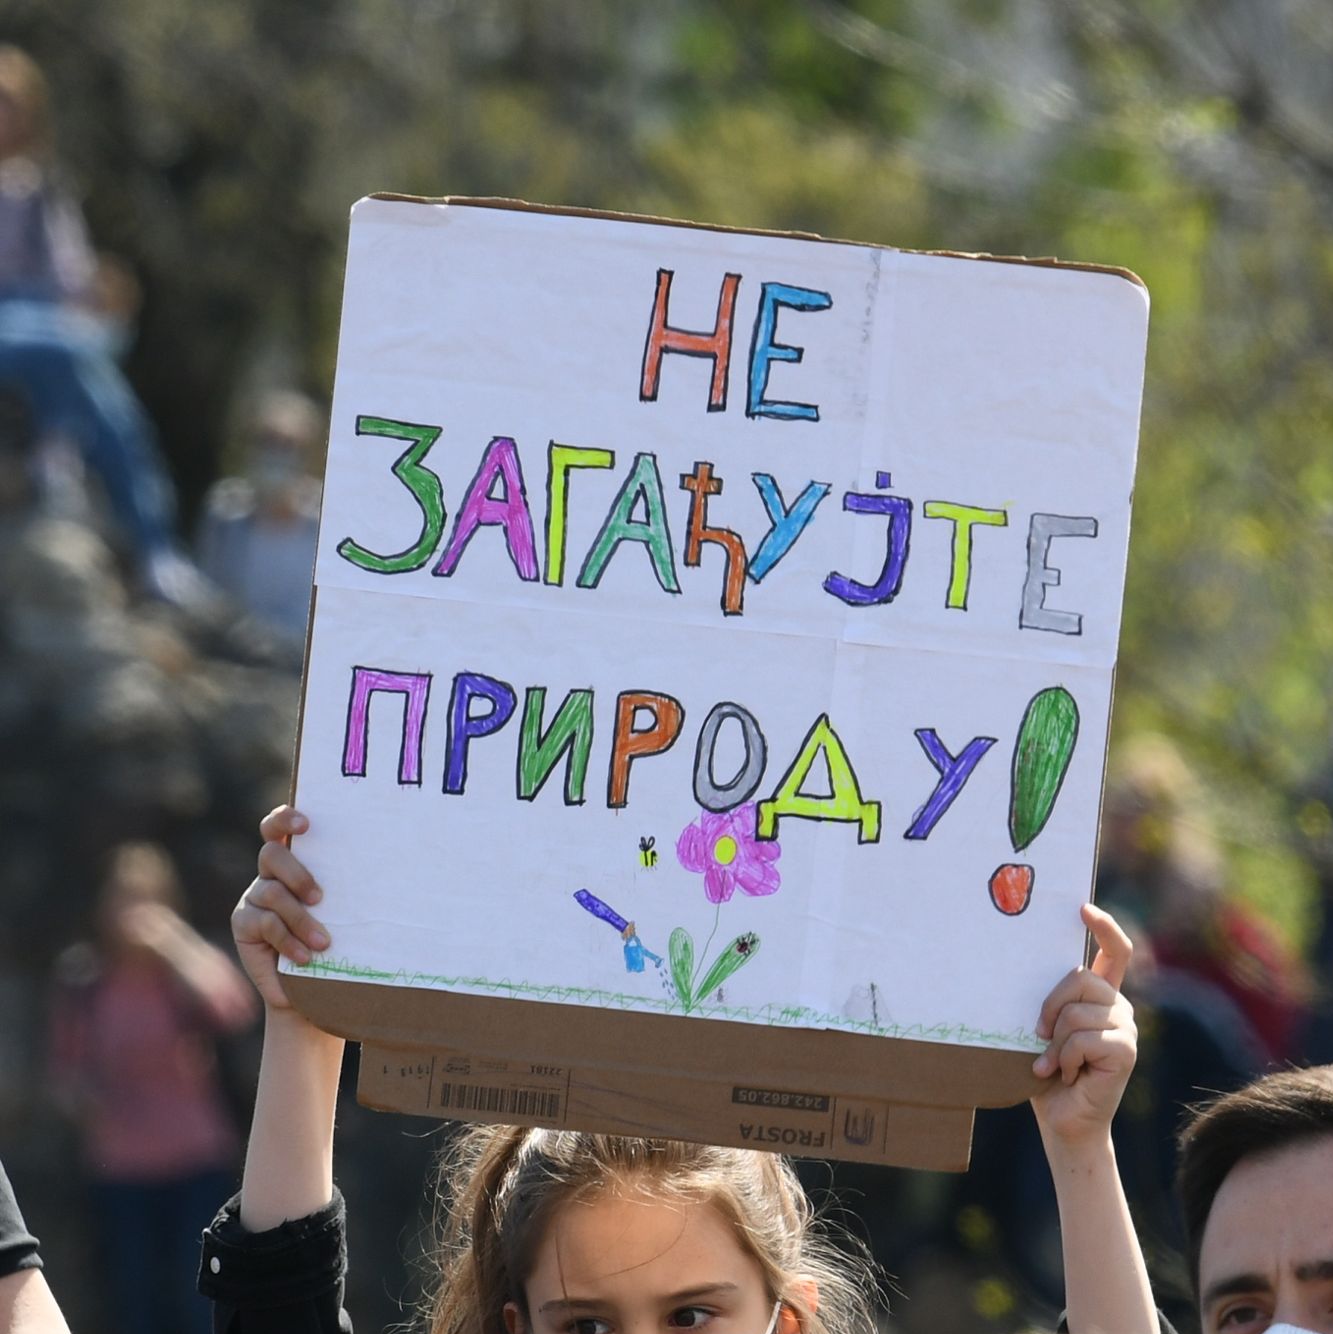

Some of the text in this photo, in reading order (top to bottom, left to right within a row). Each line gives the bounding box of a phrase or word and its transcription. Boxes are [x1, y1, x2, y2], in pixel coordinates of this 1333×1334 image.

[638, 268, 833, 422] НЕ
[341, 666, 1081, 916] ПРИРОДУ!
[738, 1089, 823, 1109] 242.862.05
[739, 1122, 826, 1148] FROSTA
